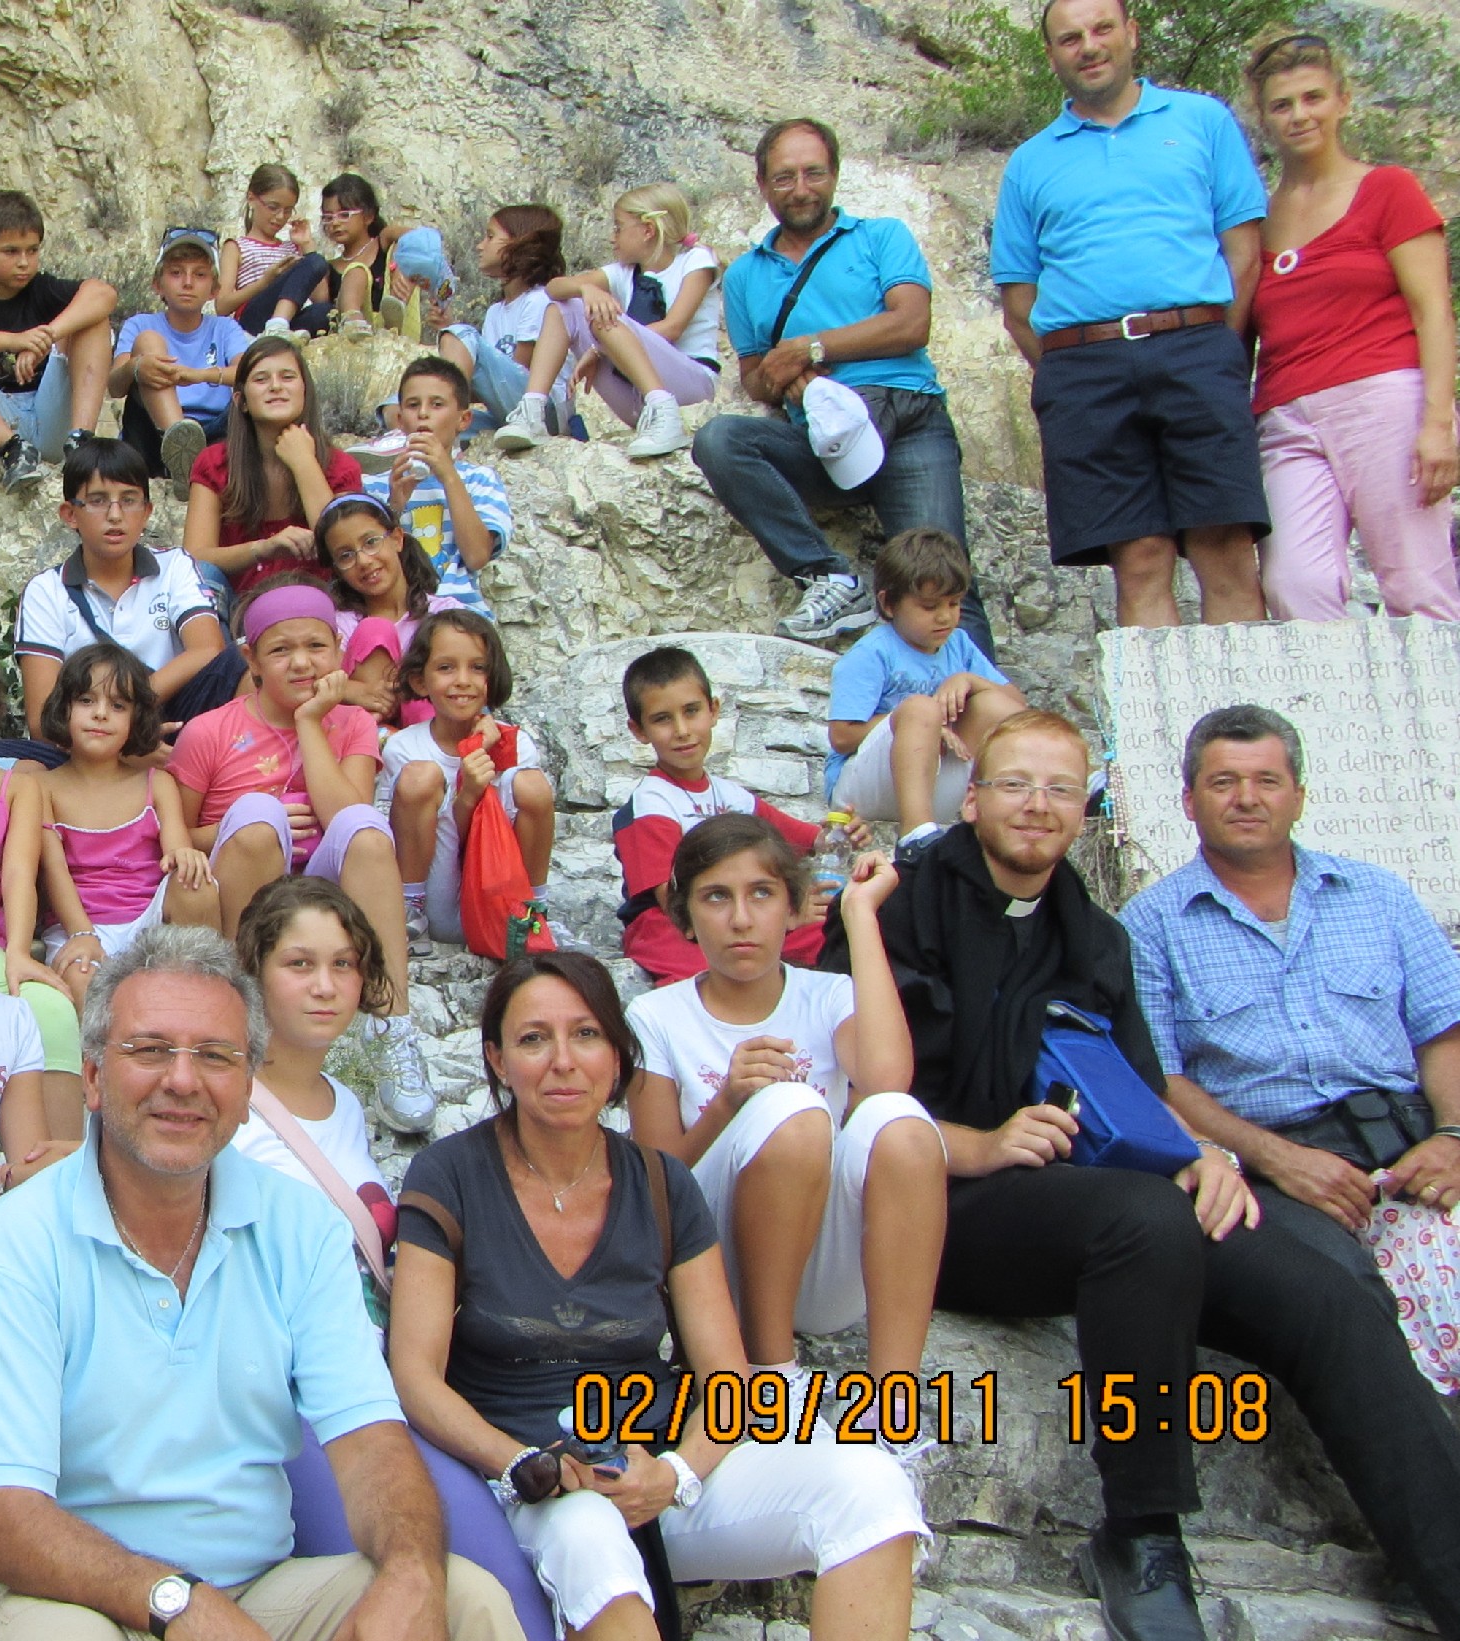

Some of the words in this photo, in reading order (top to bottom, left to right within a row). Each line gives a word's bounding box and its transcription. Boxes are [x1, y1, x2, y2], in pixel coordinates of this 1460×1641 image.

[1167, 662, 1252, 687] buona
[1349, 651, 1456, 685] parente
[1405, 717, 1448, 741] due
[1358, 778, 1392, 804] ad
[1313, 810, 1403, 836] cariche
